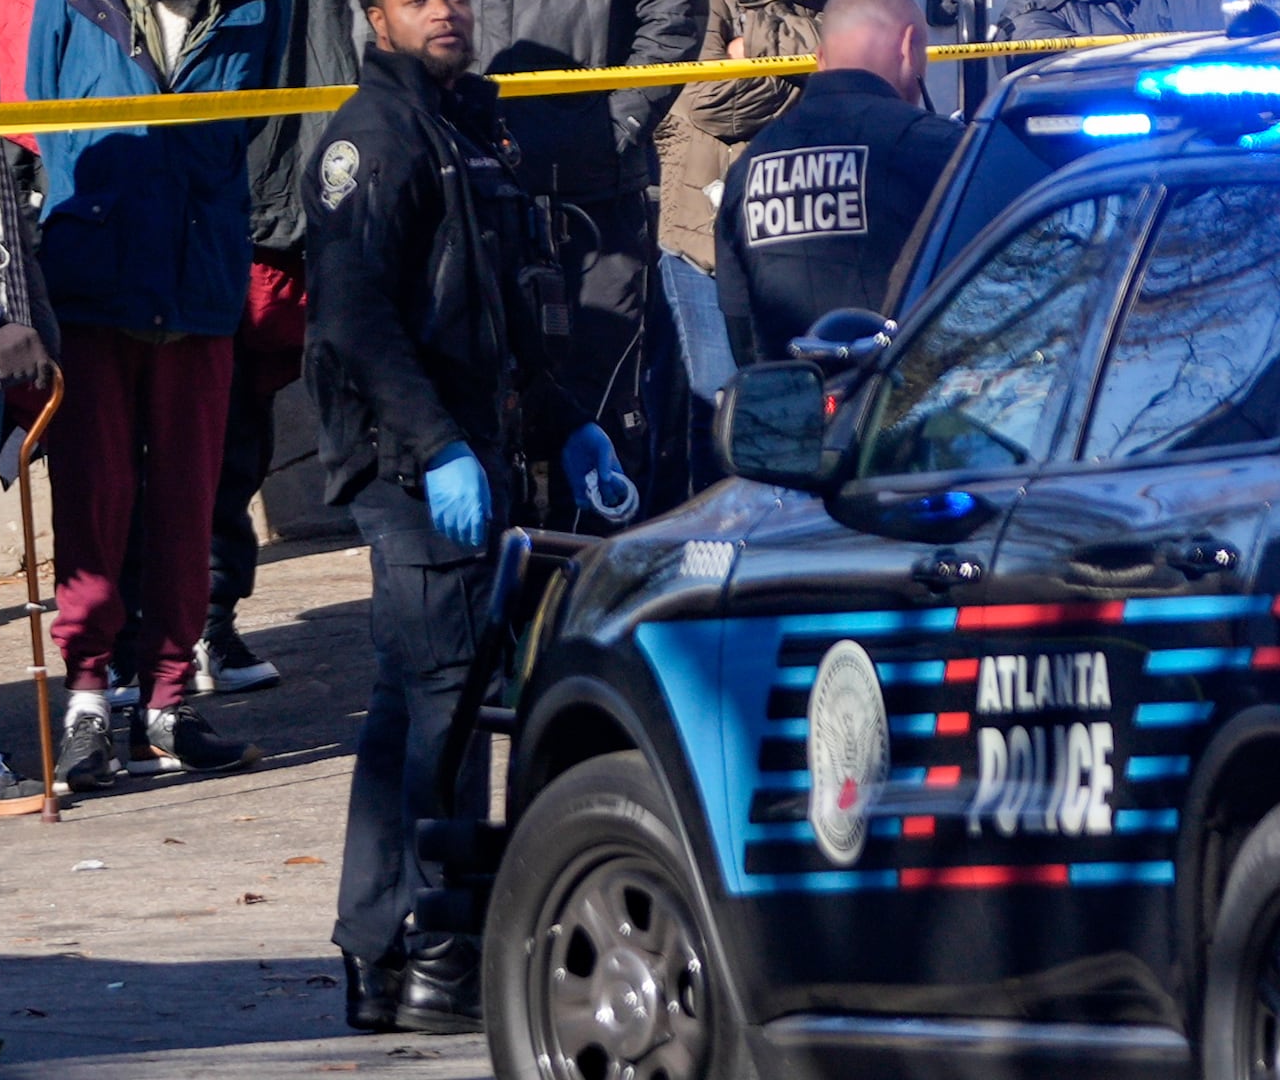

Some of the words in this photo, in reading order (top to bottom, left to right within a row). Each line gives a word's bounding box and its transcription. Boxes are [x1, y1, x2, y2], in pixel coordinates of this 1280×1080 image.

[749, 151, 859, 198] ATLANTA
[747, 191, 861, 239] POLICE
[977, 651, 1112, 715] ATLANTA
[967, 721, 1114, 838] POLICE
